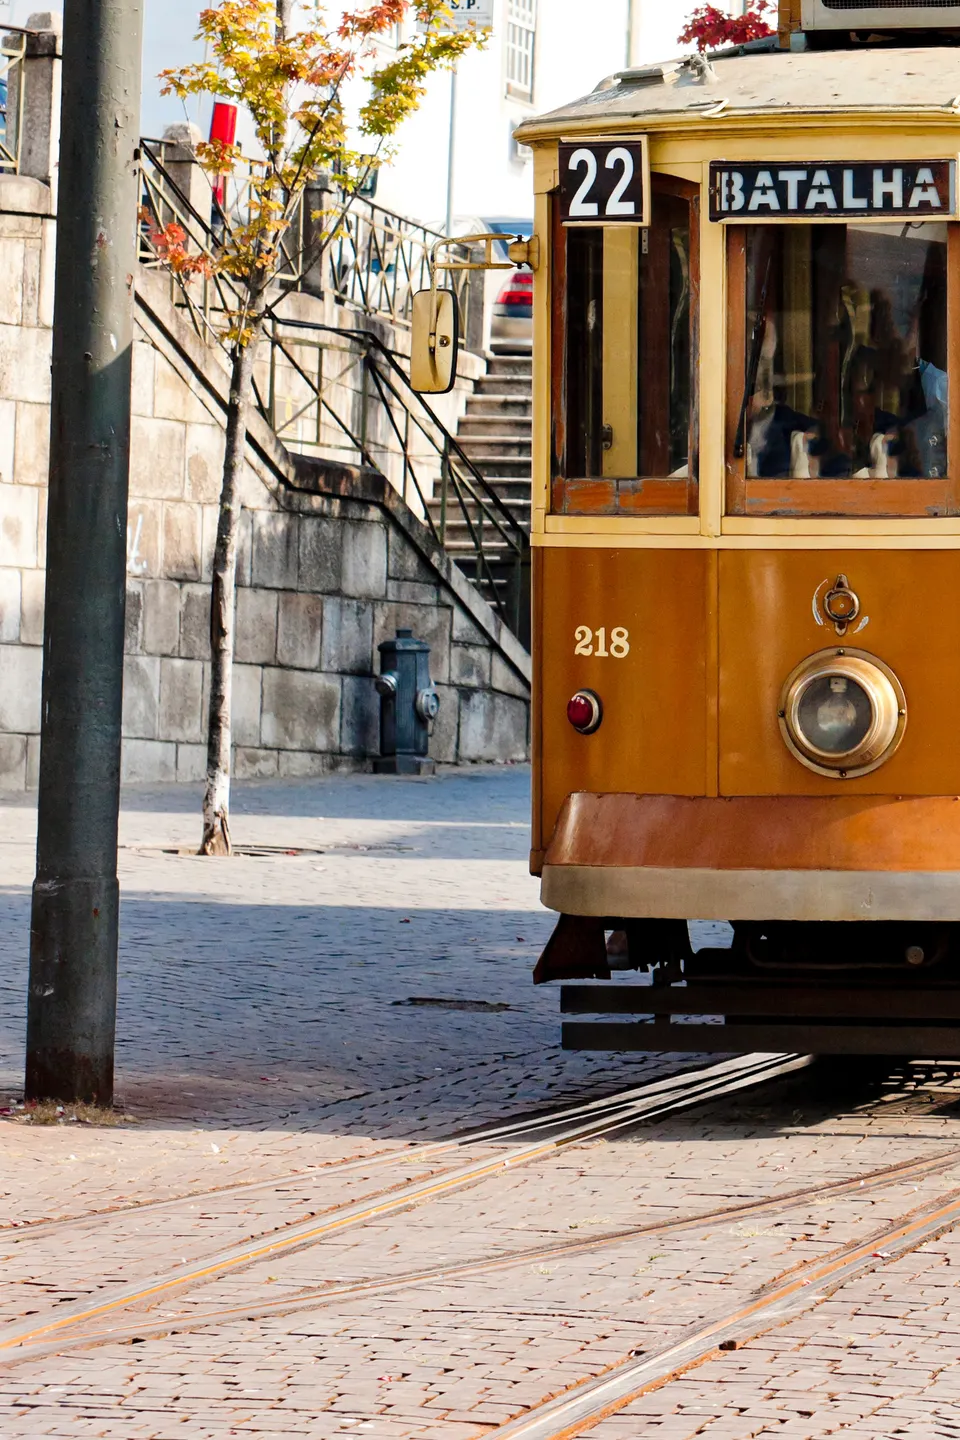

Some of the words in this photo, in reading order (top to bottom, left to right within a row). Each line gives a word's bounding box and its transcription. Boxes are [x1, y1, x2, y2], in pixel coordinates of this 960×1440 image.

[567, 147, 636, 217] 22
[720, 167, 942, 212] BATALHA
[574, 625, 630, 659] 218
